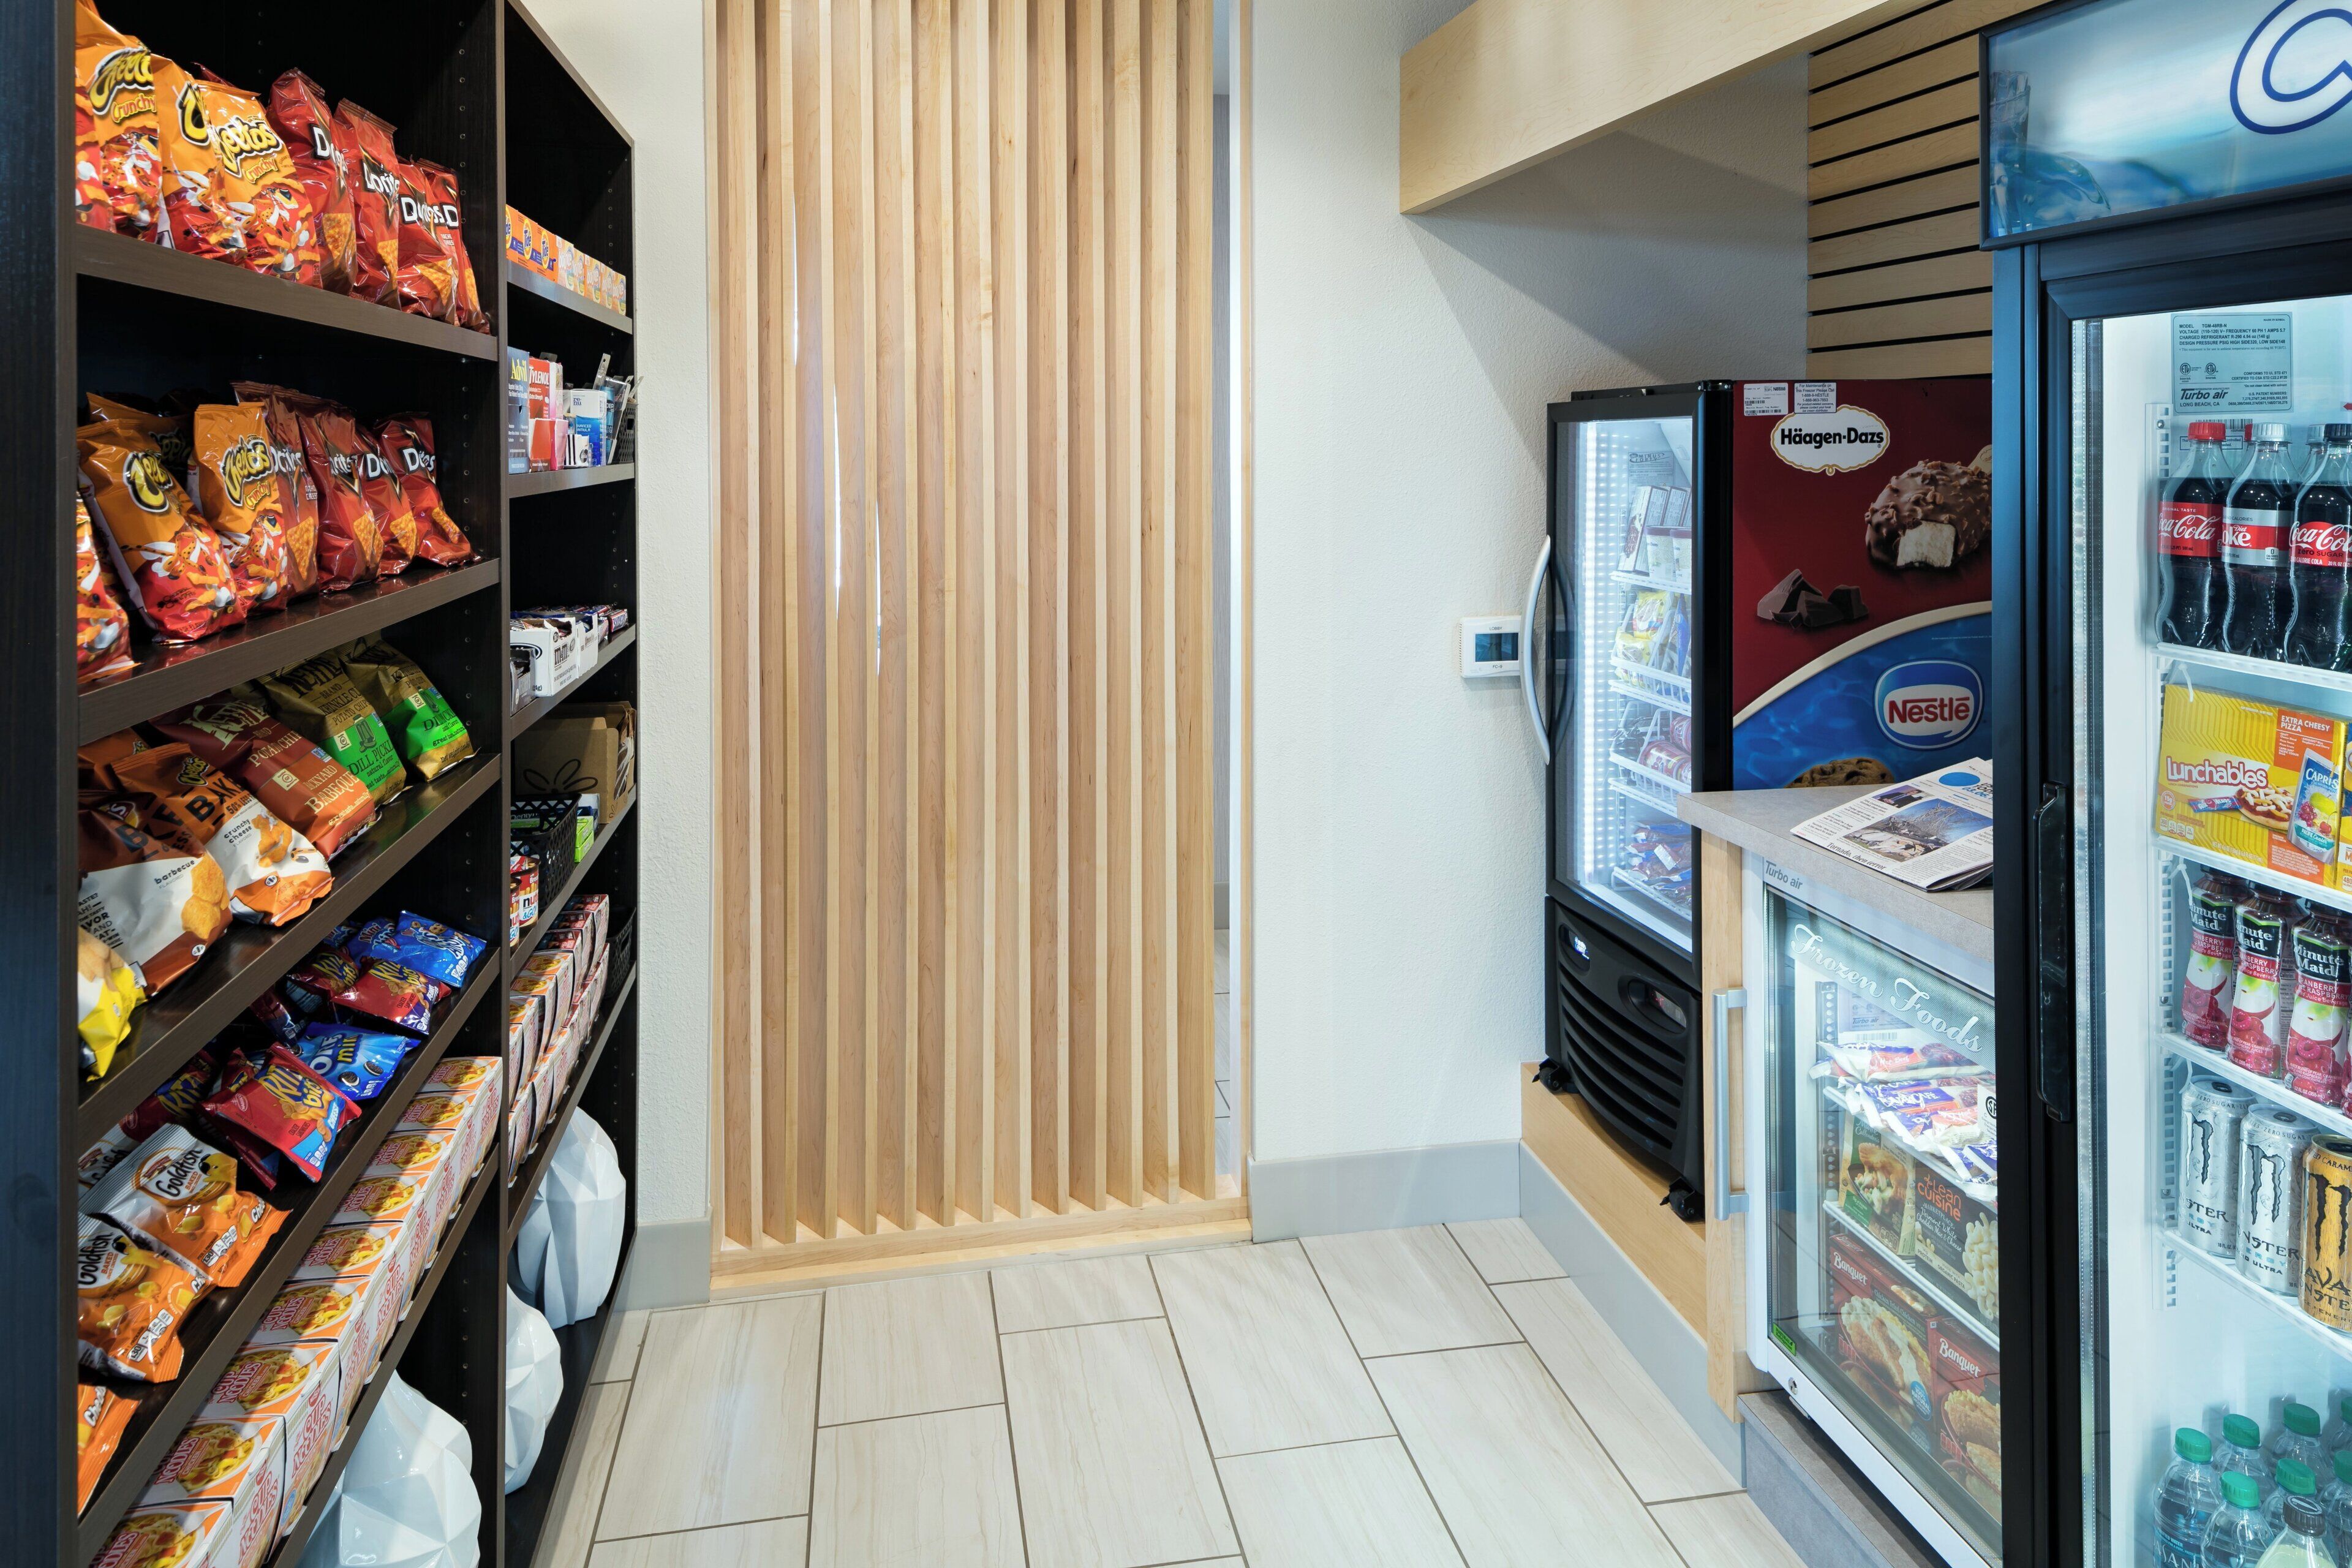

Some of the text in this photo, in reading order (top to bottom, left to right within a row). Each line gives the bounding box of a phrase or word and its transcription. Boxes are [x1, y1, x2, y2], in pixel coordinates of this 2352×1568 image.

[524, 228, 532, 248] Tide
[511, 357, 527, 382] Advil
[529, 366, 549, 385] TYLENOL
[2180, 388, 2228, 400] Turbo air
[1781, 427, 1884, 449] Häagen-Dazs
[224, 440, 273, 506] Cheetos
[246, 480, 271, 509] Crunchy
[2158, 513, 2221, 540] Coca-Cola
[2222, 526, 2252, 547] oke
[321, 683, 342, 699] BRAND
[332, 707, 356, 726] POTATO
[2280, 722, 2302, 733] PIZZA
[2281, 715, 2331, 732] EXTRA CHEESY
[347, 753, 374, 776] DILL
[367, 755, 394, 778] natural flavor
[2167, 757, 2267, 788] Lunchables
[224, 818, 251, 840] crunchy
[228, 825, 252, 844] cheese
[233, 833, 252, 848] FLAVORED
[1826, 842, 1887, 870] Tornado, then terror
[154, 859, 195, 885] barbecue
[159, 873, 184, 889] FLAVORED
[1765, 861, 1803, 891] Turbo air
[93, 920, 113, 934] AND
[2294, 944, 2345, 966] Minute
[2300, 957, 2337, 977] Maid
[1790, 924, 1983, 1053] Frozen Foods
[2306, 993, 2322, 1001] Juice
[2196, 1093, 2236, 1109] ZERO SUGAR
[2263, 1126, 2306, 1142] ZERO SUGAR
[155, 1148, 203, 1198] Goldfish
[184, 1170, 198, 1190] BAKED
[344, 1185, 372, 1213] NOODLES
[1933, 1179, 1962, 1210] Lean
[1917, 1212, 1934, 1233] Cheddar
[1934, 1227, 1943, 1239] Mac
[1947, 1236, 1962, 1253] Cheese
[1921, 1207, 1958, 1241] Vermont White
[100, 1251, 115, 1275] BAKED
[309, 1237, 342, 1267] NOODLES
[1917, 1249, 1933, 1265] PROTEIN
[1833, 1251, 1868, 1286] Banquet
[1937, 1264, 1966, 1291] ORGANIC PASTA
[2253, 1260, 2283, 1275] ULTRA
[1873, 1288, 1890, 1305] Chicken
[262, 1304, 284, 1325] CUP
[271, 1295, 306, 1331] NOODLES
[1939, 1336, 1982, 1379] Banquet
[213, 1370, 236, 1395] CUP
[217, 1361, 263, 1404] NOODLES
[303, 1394, 326, 1437] CUP
[292, 1401, 331, 1479] NOODLES
[155, 1437, 200, 1485] NOODLES
[251, 1471, 273, 1523] CUP
[238, 1478, 279, 1565] NOODLES
